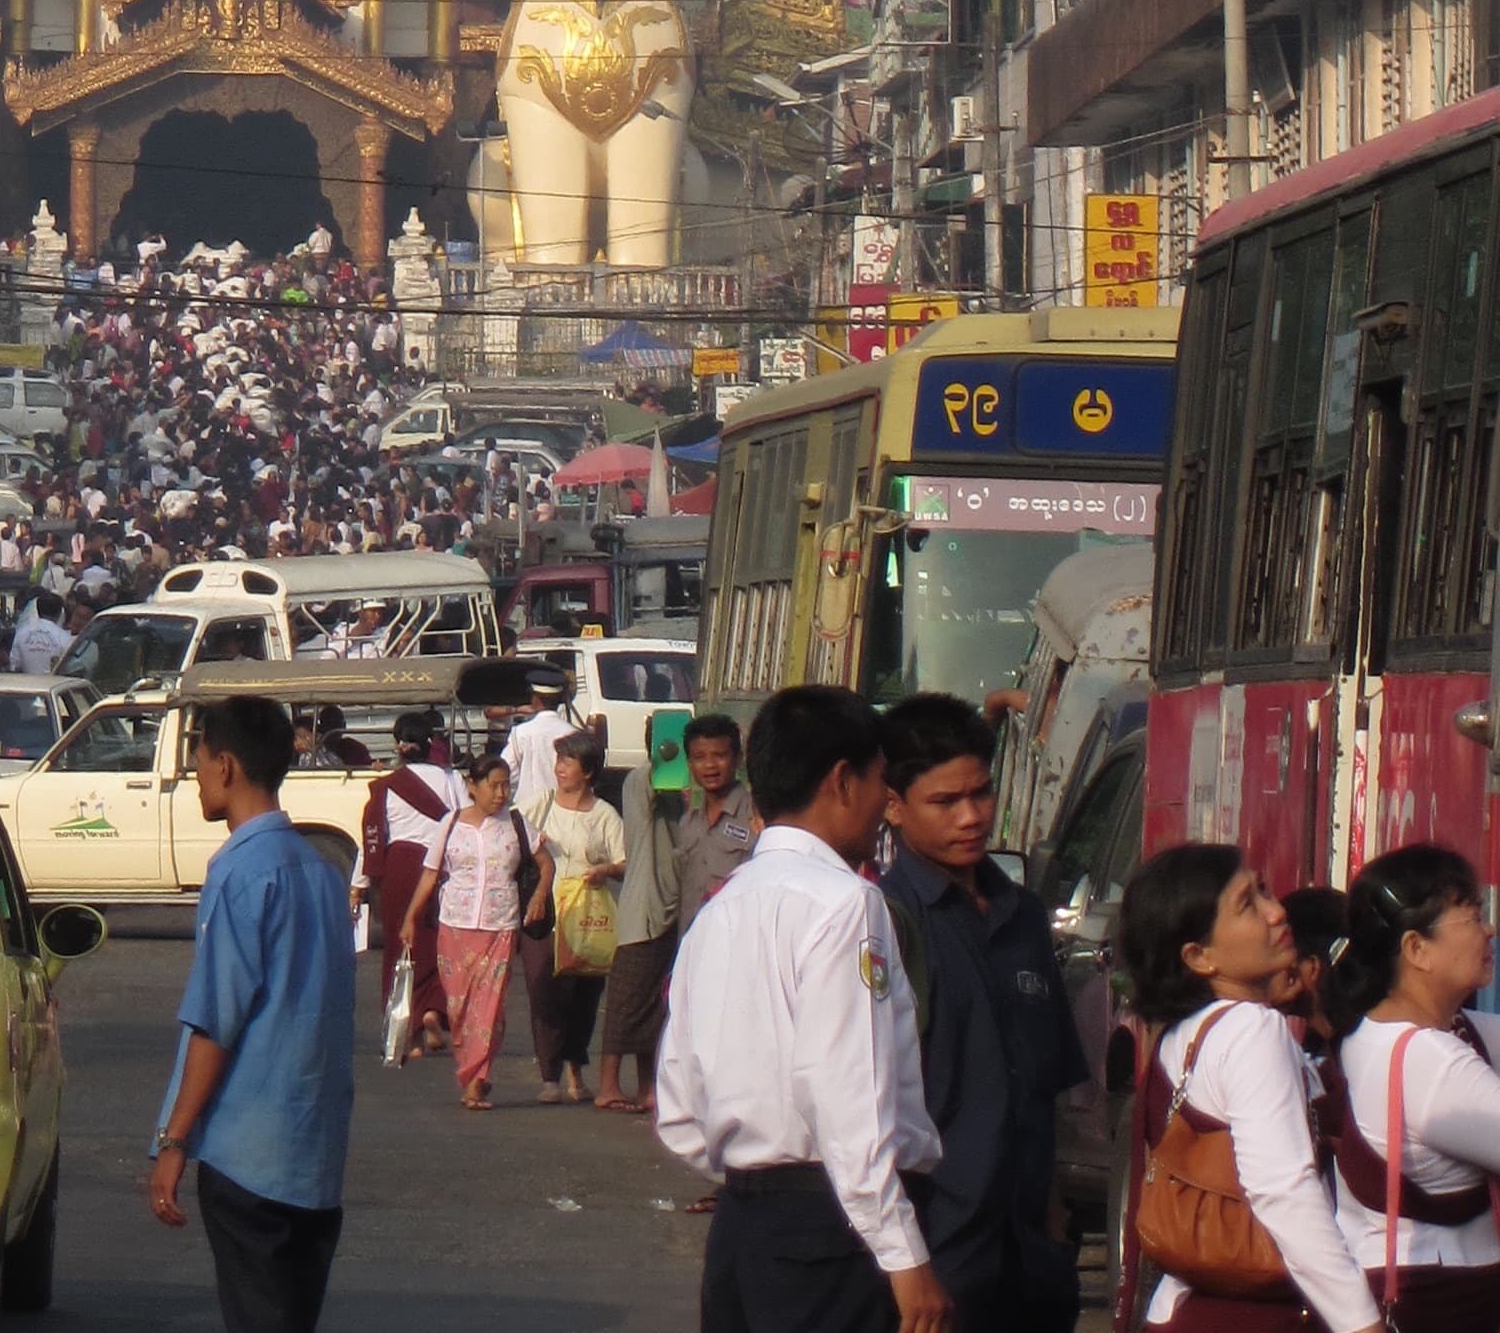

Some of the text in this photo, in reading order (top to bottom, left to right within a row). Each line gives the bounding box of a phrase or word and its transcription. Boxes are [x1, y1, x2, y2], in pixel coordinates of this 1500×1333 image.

[944, 383, 999, 435] ၃၉
[55, 829, 119, 839] moving forward
